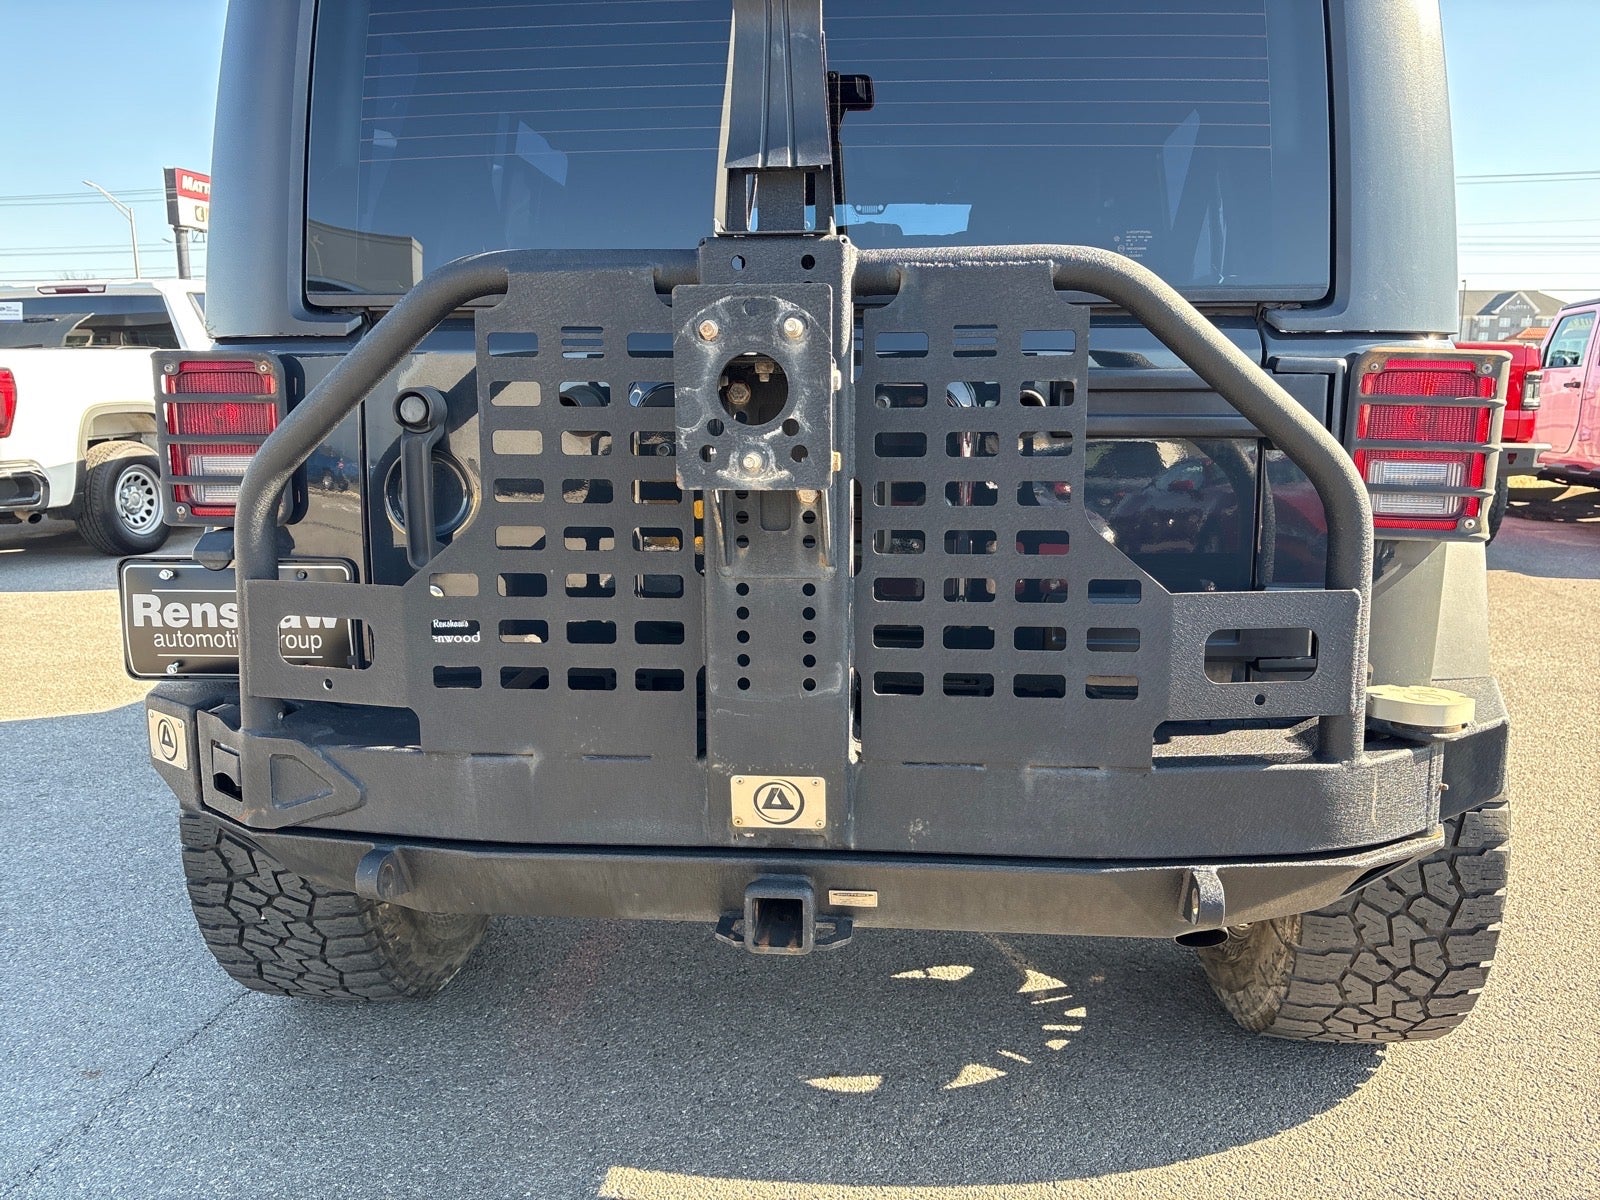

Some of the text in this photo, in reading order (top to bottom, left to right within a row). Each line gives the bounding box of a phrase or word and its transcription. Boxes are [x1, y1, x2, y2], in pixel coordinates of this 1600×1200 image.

[132, 593, 338, 629] Rensa
[153, 629, 323, 654] automoti roup
